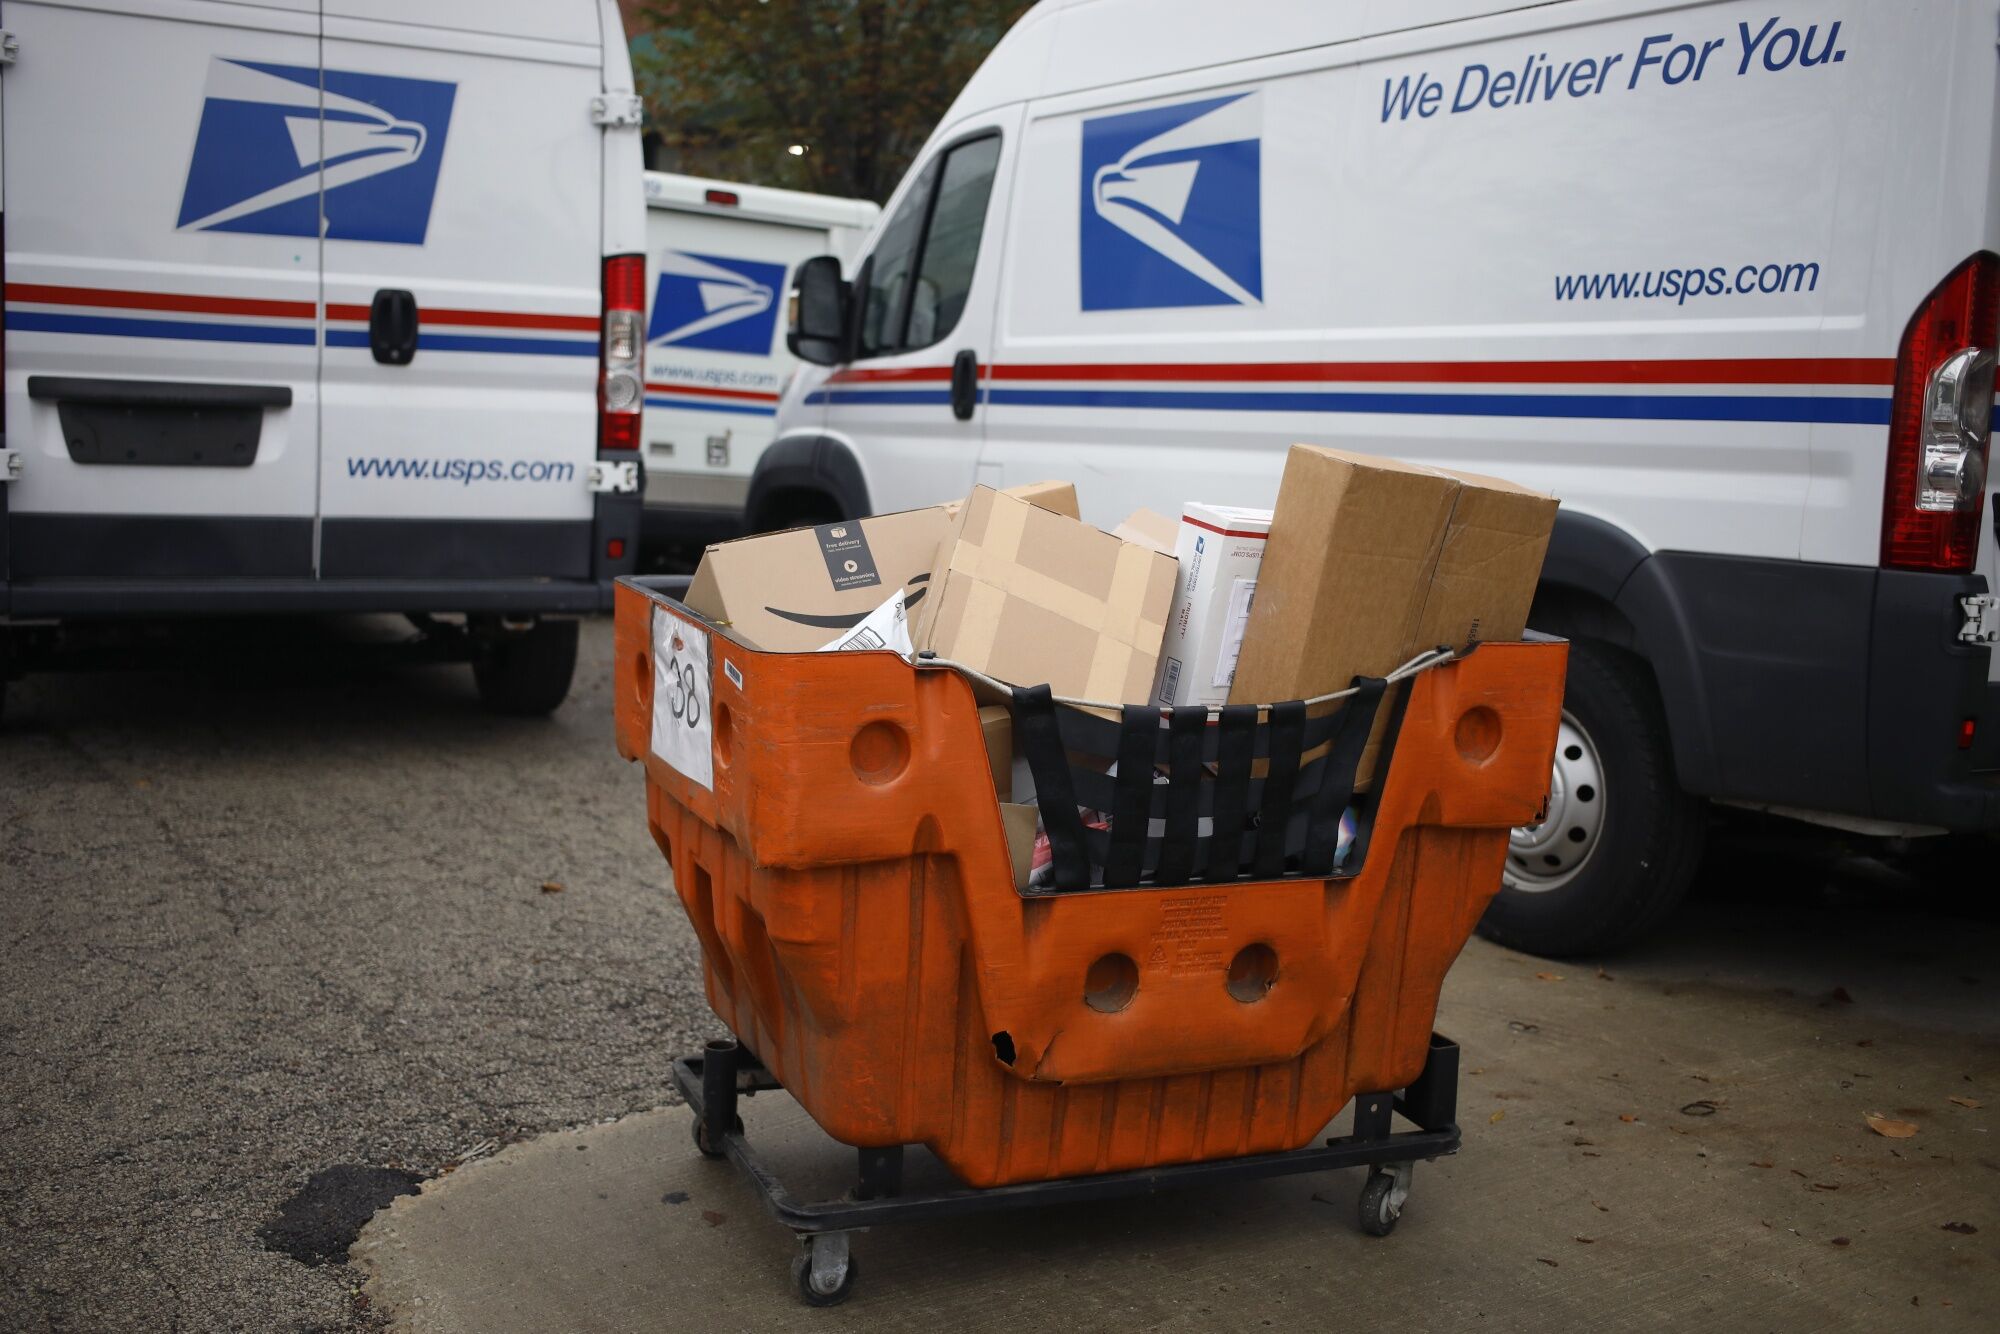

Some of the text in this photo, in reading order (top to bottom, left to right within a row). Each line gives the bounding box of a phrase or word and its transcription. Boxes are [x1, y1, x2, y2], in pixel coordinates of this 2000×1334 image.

[1380, 16, 1847, 123] We Deliver For You.
[1555, 261, 1820, 305] www.usps.com
[651, 364, 779, 387] www.usps.com
[347, 456, 575, 486] www.usps.com
[839, 539, 860, 547] delivery
[849, 572, 875, 581] streaming
[1178, 608, 1186, 626] MAIL
[670, 655, 700, 729] 38
